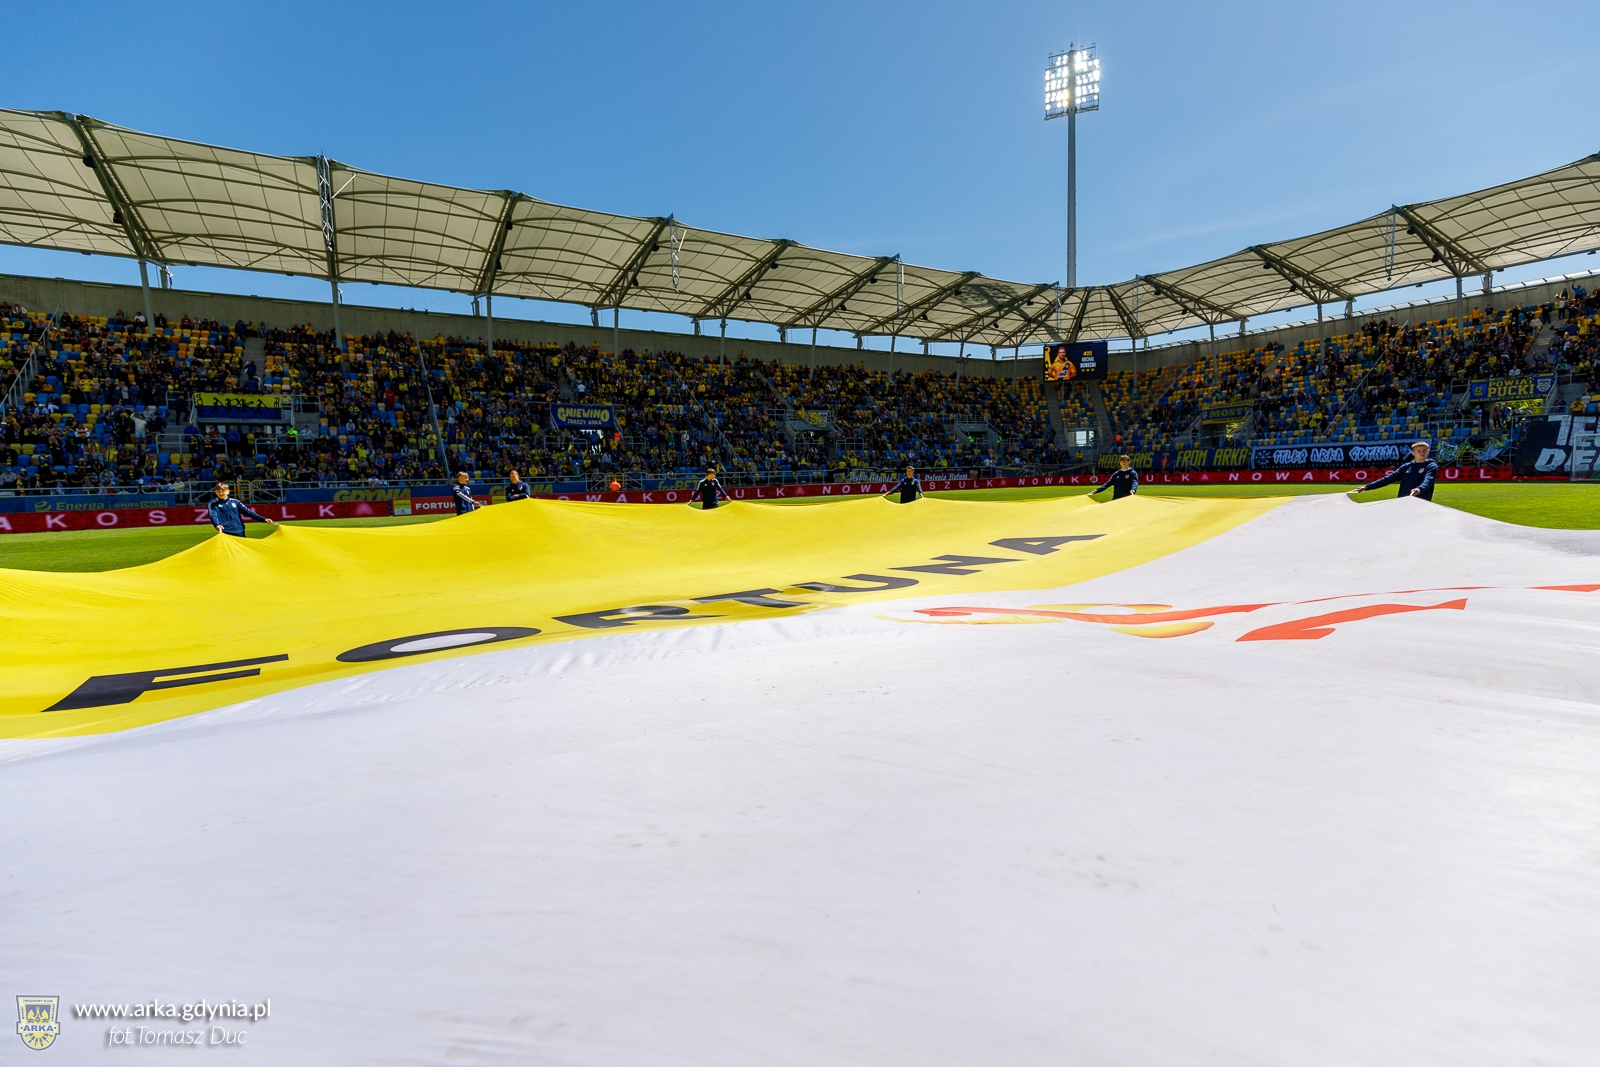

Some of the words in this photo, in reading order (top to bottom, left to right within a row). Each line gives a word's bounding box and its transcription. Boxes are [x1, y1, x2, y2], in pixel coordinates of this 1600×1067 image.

[1488, 378, 1534, 388] POWIAT
[1487, 384, 1534, 398] PUCKI
[557, 407, 610, 422] GNIEWINO
[1210, 406, 1250, 418] MOSTY
[1098, 452, 1154, 468] HOOLGANS
[1176, 450, 1208, 466] FROM
[1213, 448, 1249, 466] ARKA
[1310, 448, 1344, 463] ARKA
[1349, 445, 1400, 461] GDYNIA
[1534, 448, 1600, 472] DE
[1071, 474, 1209, 484] KOULKA
[1229, 472, 1314, 482] NOWA
[333, 489, 411, 501] GDYNIA
[56, 502, 104, 511] Energa
[416, 500, 456, 511] FORTUN
[41, 534, 1107, 713] FORTUNA
